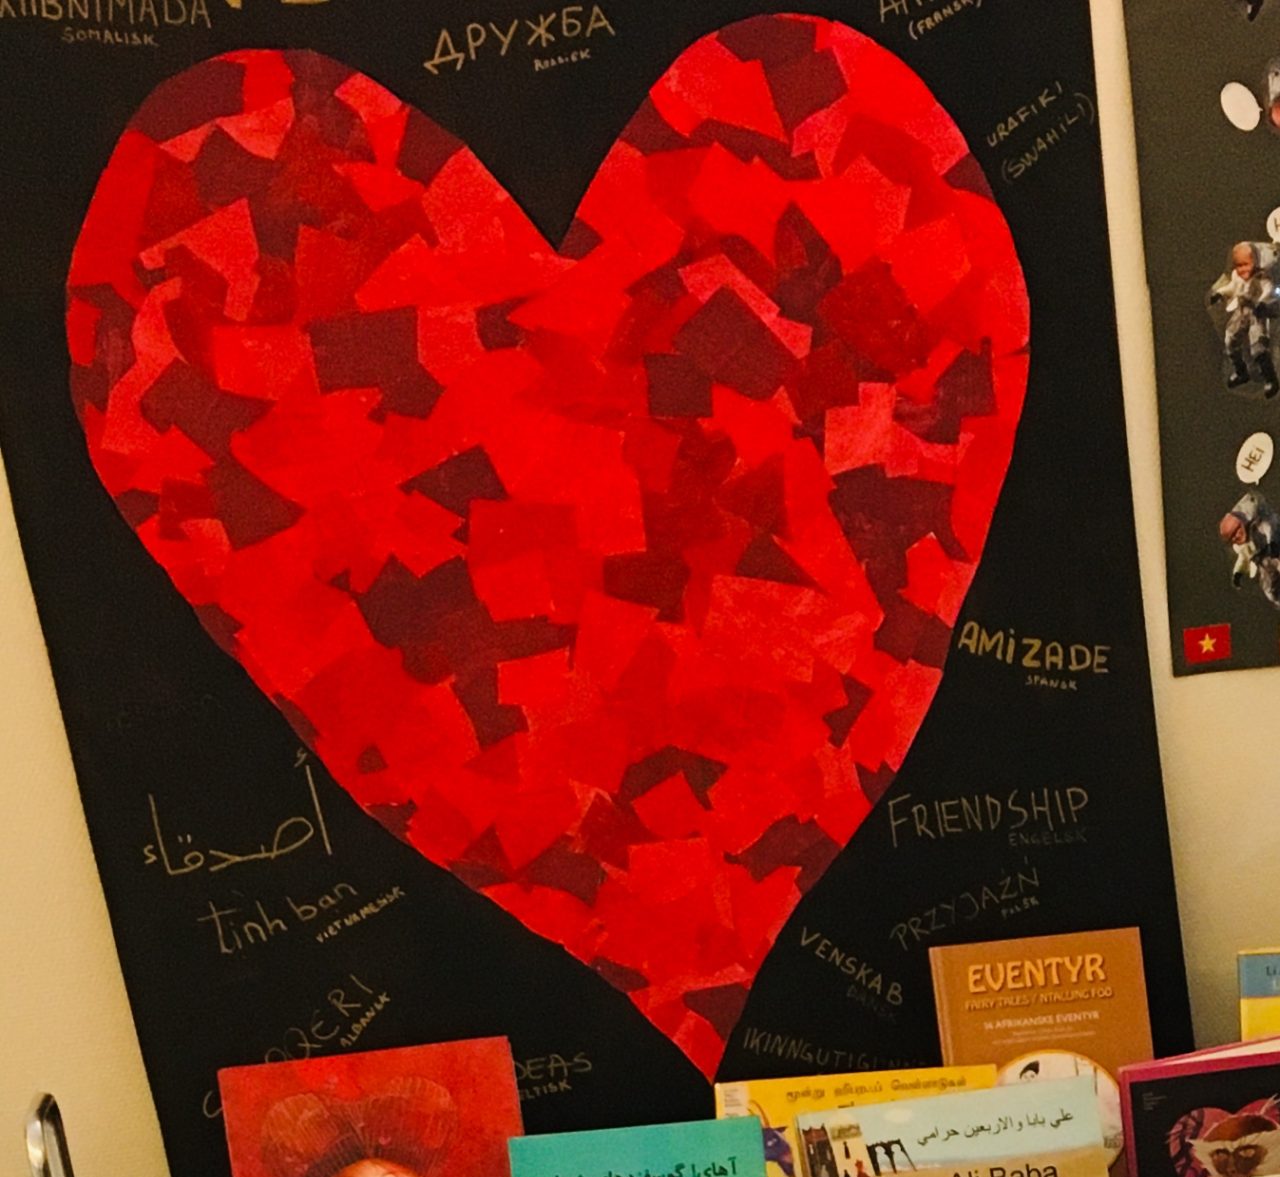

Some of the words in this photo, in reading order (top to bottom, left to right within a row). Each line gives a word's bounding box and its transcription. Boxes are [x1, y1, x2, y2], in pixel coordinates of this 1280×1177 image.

[61, 26, 160, 47] SOMALISK
[423, 4, 616, 75] ДРУЖБА
[1241, 446, 1265, 473] HEI
[887, 786, 1090, 848] FRIENDSHIP
[801, 926, 904, 1006] VENSKAB
[968, 953, 1107, 993] EVENTYR
